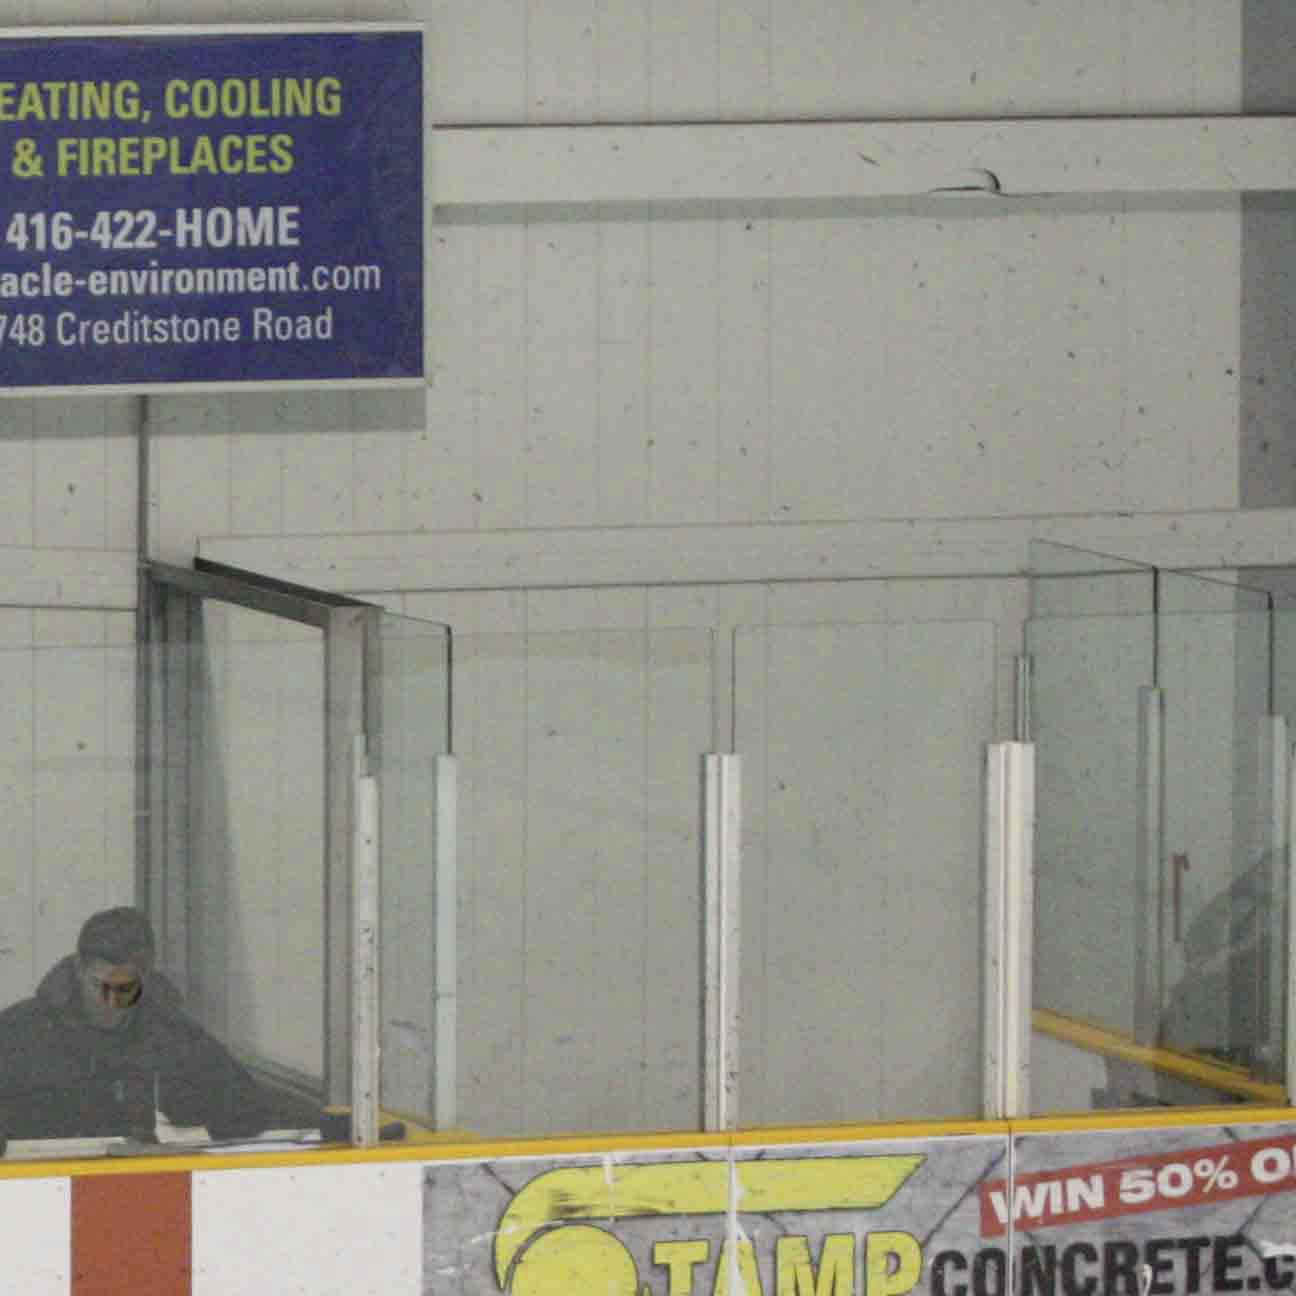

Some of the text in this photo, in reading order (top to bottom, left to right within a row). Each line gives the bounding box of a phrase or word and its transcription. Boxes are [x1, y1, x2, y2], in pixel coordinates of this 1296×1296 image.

[164, 76, 342, 119] COOLING
[11, 133, 295, 178] & FIREPLACES
[6, 205, 301, 251] 416-422-HOME
[56, 309, 241, 346] Creditstone
[252, 306, 333, 341] Road
[988, 1145, 1296, 1225] WIN 50% O
